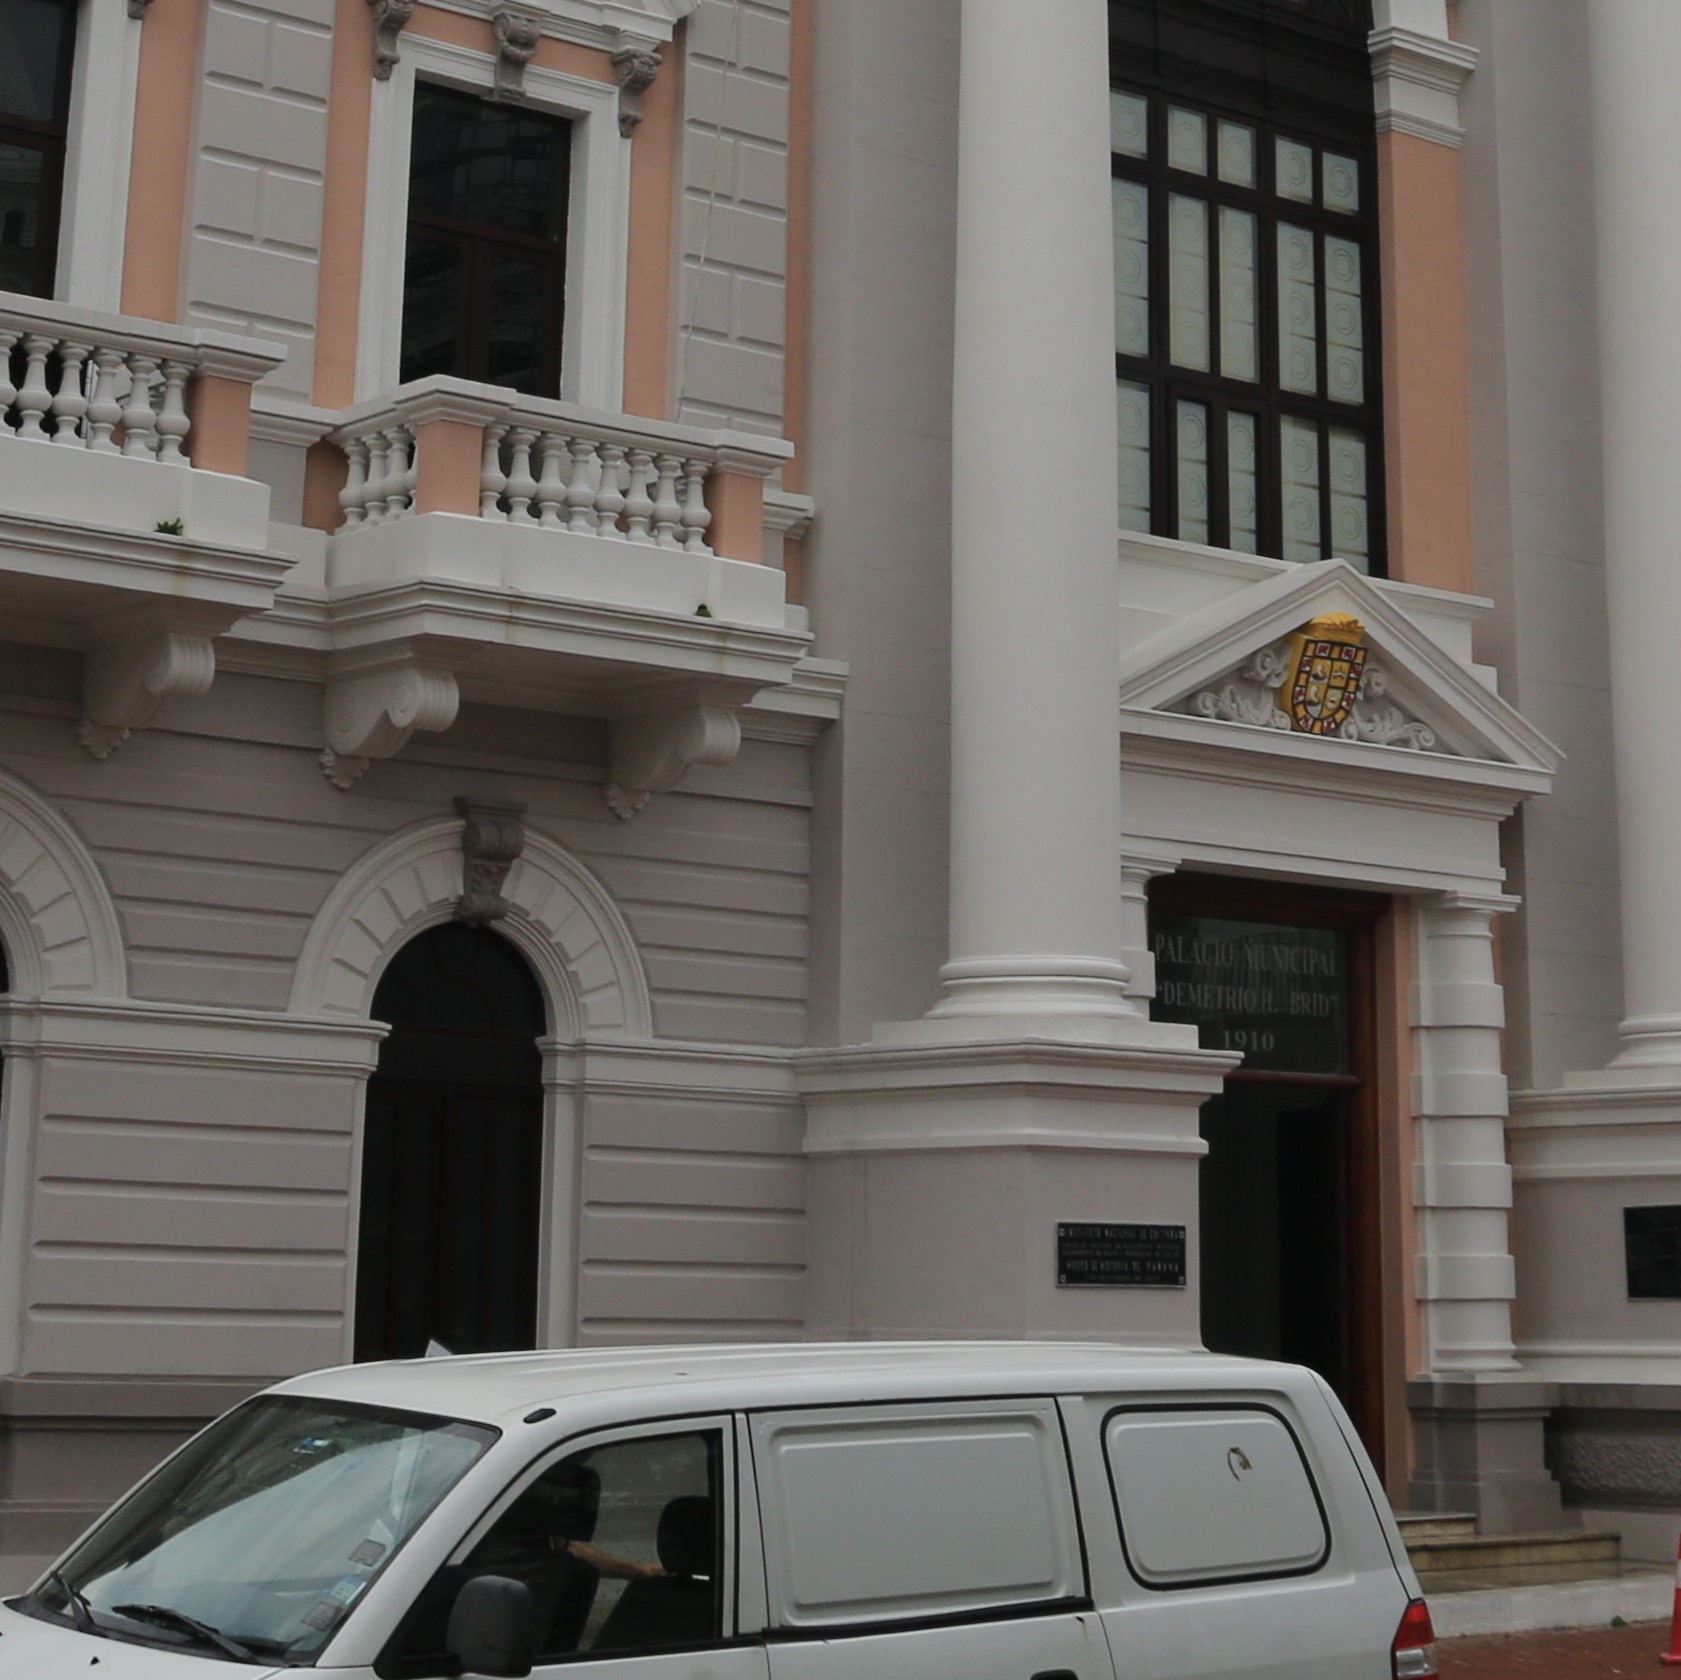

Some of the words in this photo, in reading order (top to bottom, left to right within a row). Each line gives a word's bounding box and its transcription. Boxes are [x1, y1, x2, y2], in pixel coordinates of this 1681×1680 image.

[1155, 933, 1234, 968] PALACIO
[1244, 942, 1339, 977] MUNICIPAL
[1223, 1029, 1275, 1052] 1910
